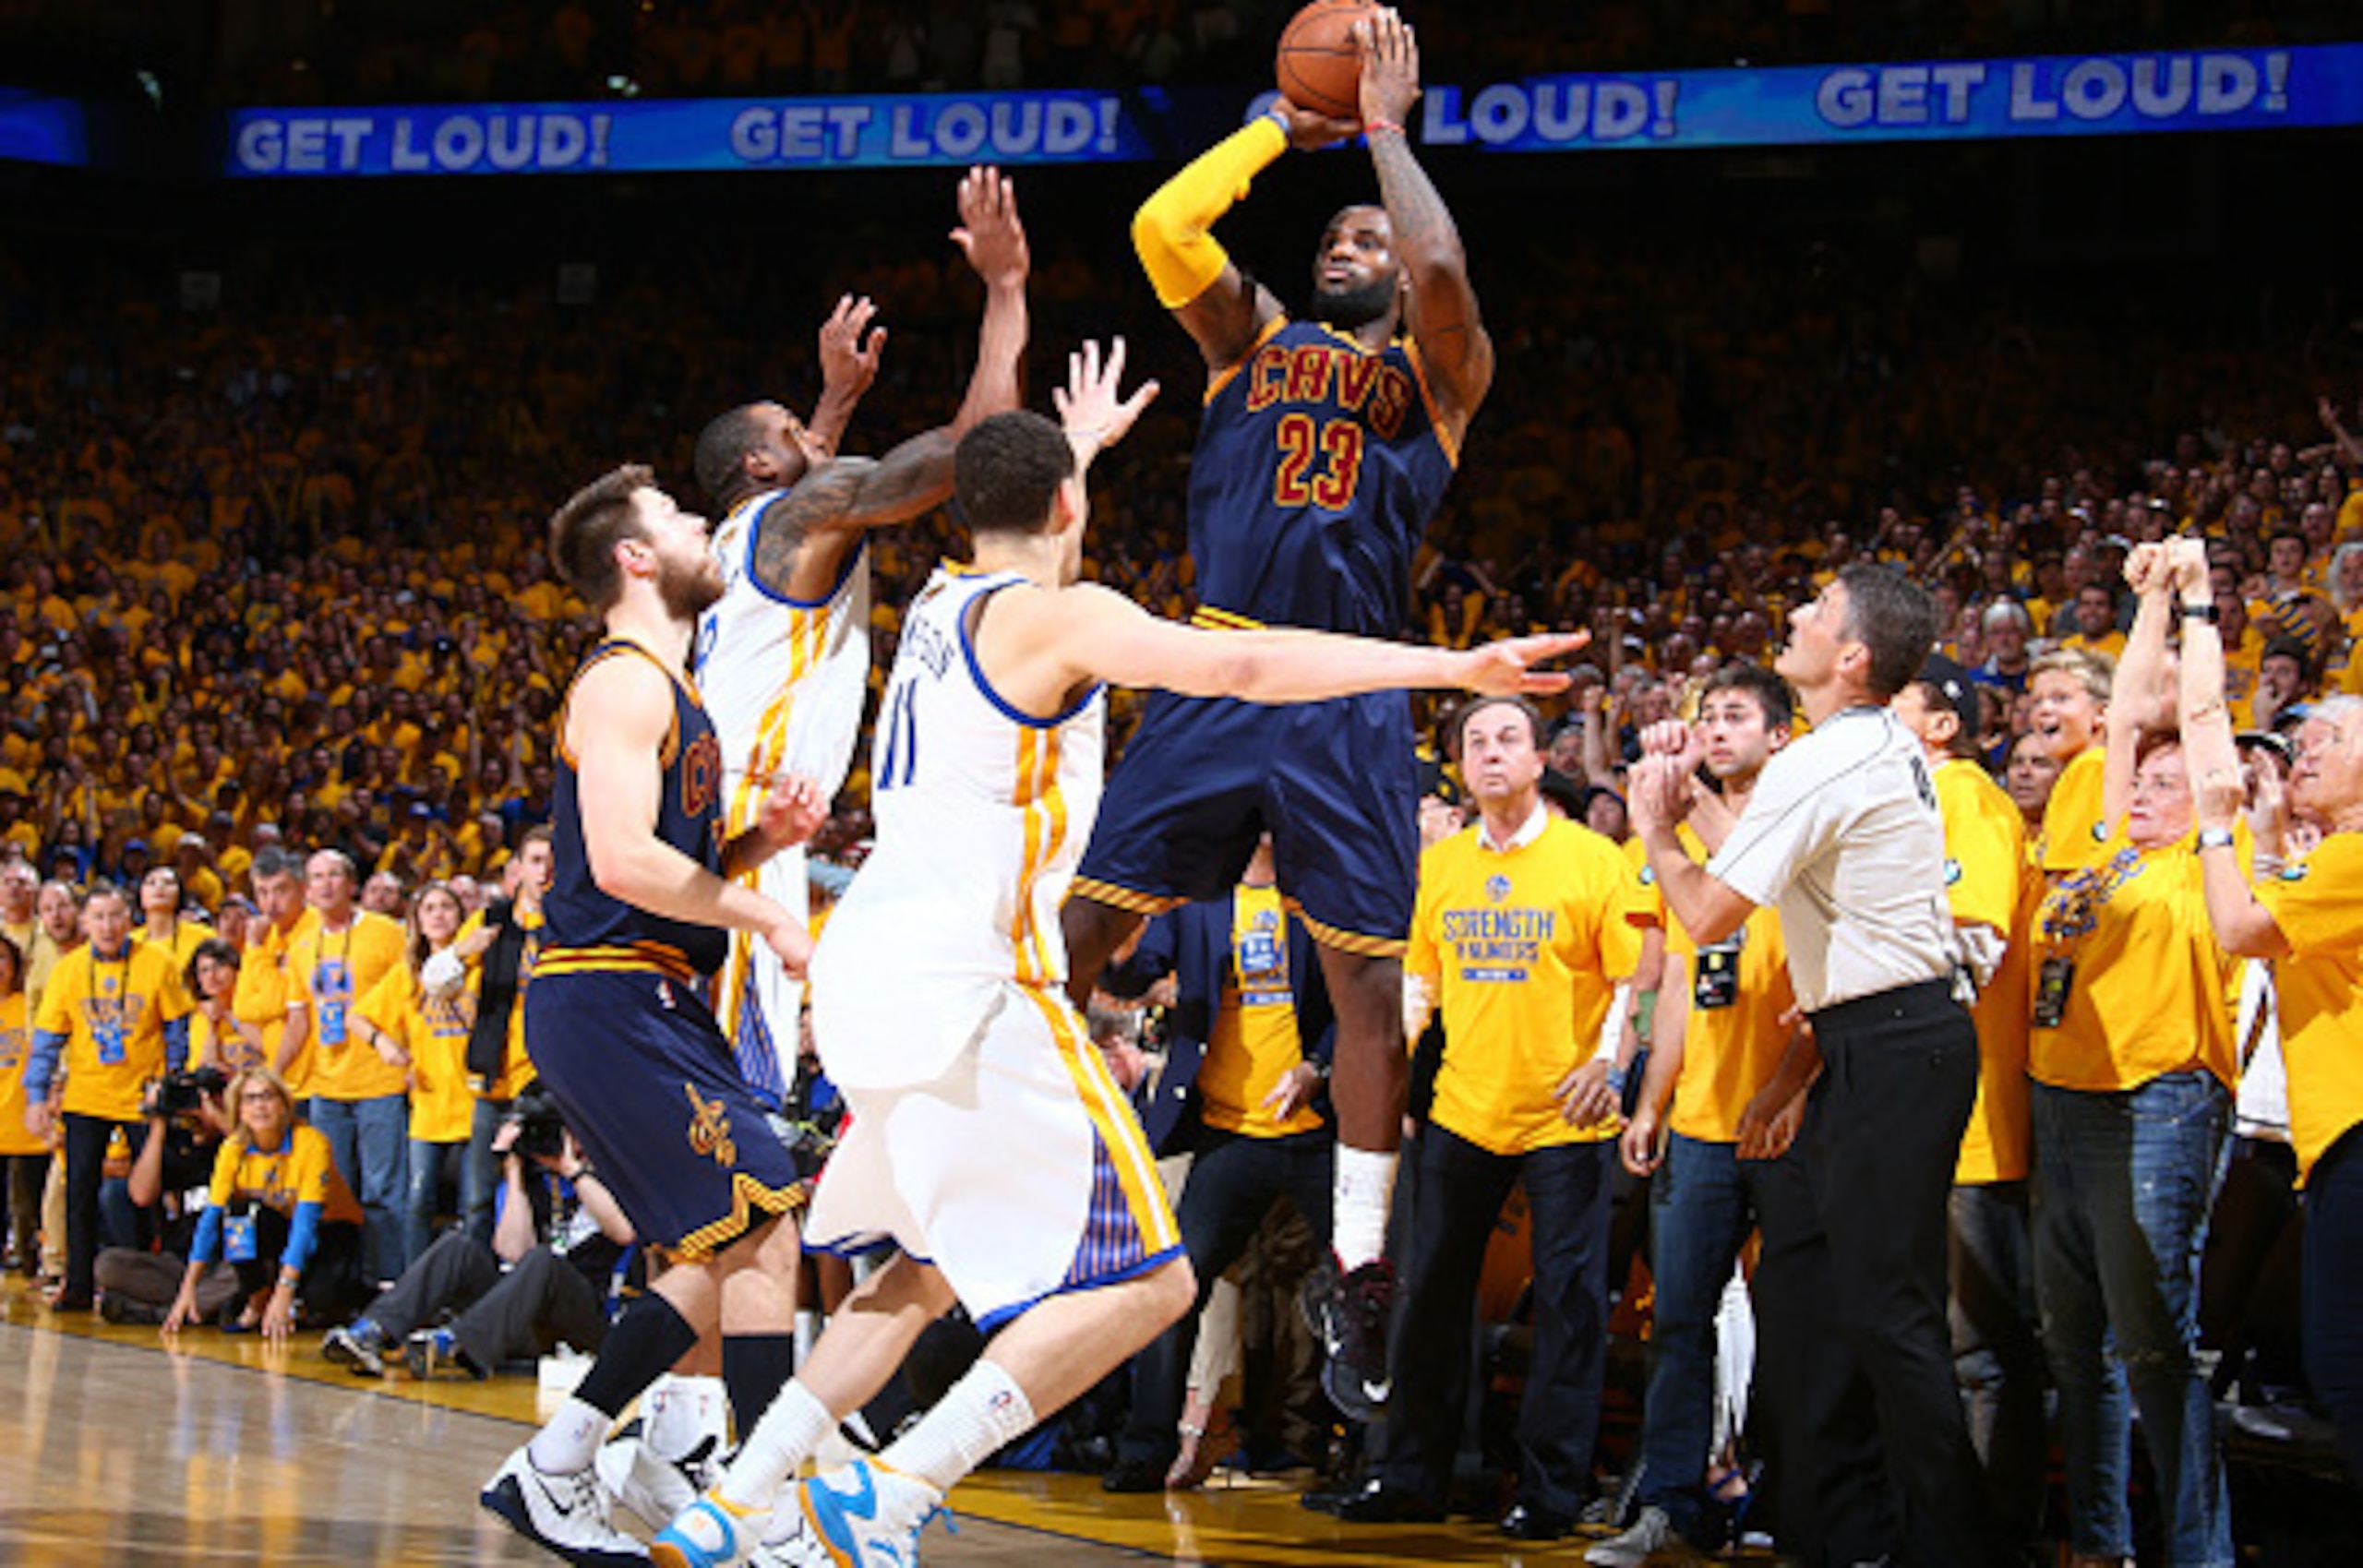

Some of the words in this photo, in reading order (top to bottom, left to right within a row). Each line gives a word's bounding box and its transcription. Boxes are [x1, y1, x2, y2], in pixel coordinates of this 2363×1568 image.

[1421, 79, 1678, 145] LOUD!
[1817, 63, 1985, 126] GET
[2010, 52, 2290, 119] LOUD!
[235, 118, 374, 173] GET
[390, 114, 611, 172] LOUD!
[730, 105, 871, 161] GET
[890, 97, 1121, 158] LOUD!
[1247, 343, 1413, 441] CAVS
[1273, 413, 1363, 510] 23
[877, 676, 917, 791] 11
[1442, 908, 1553, 941] STRENGTH
